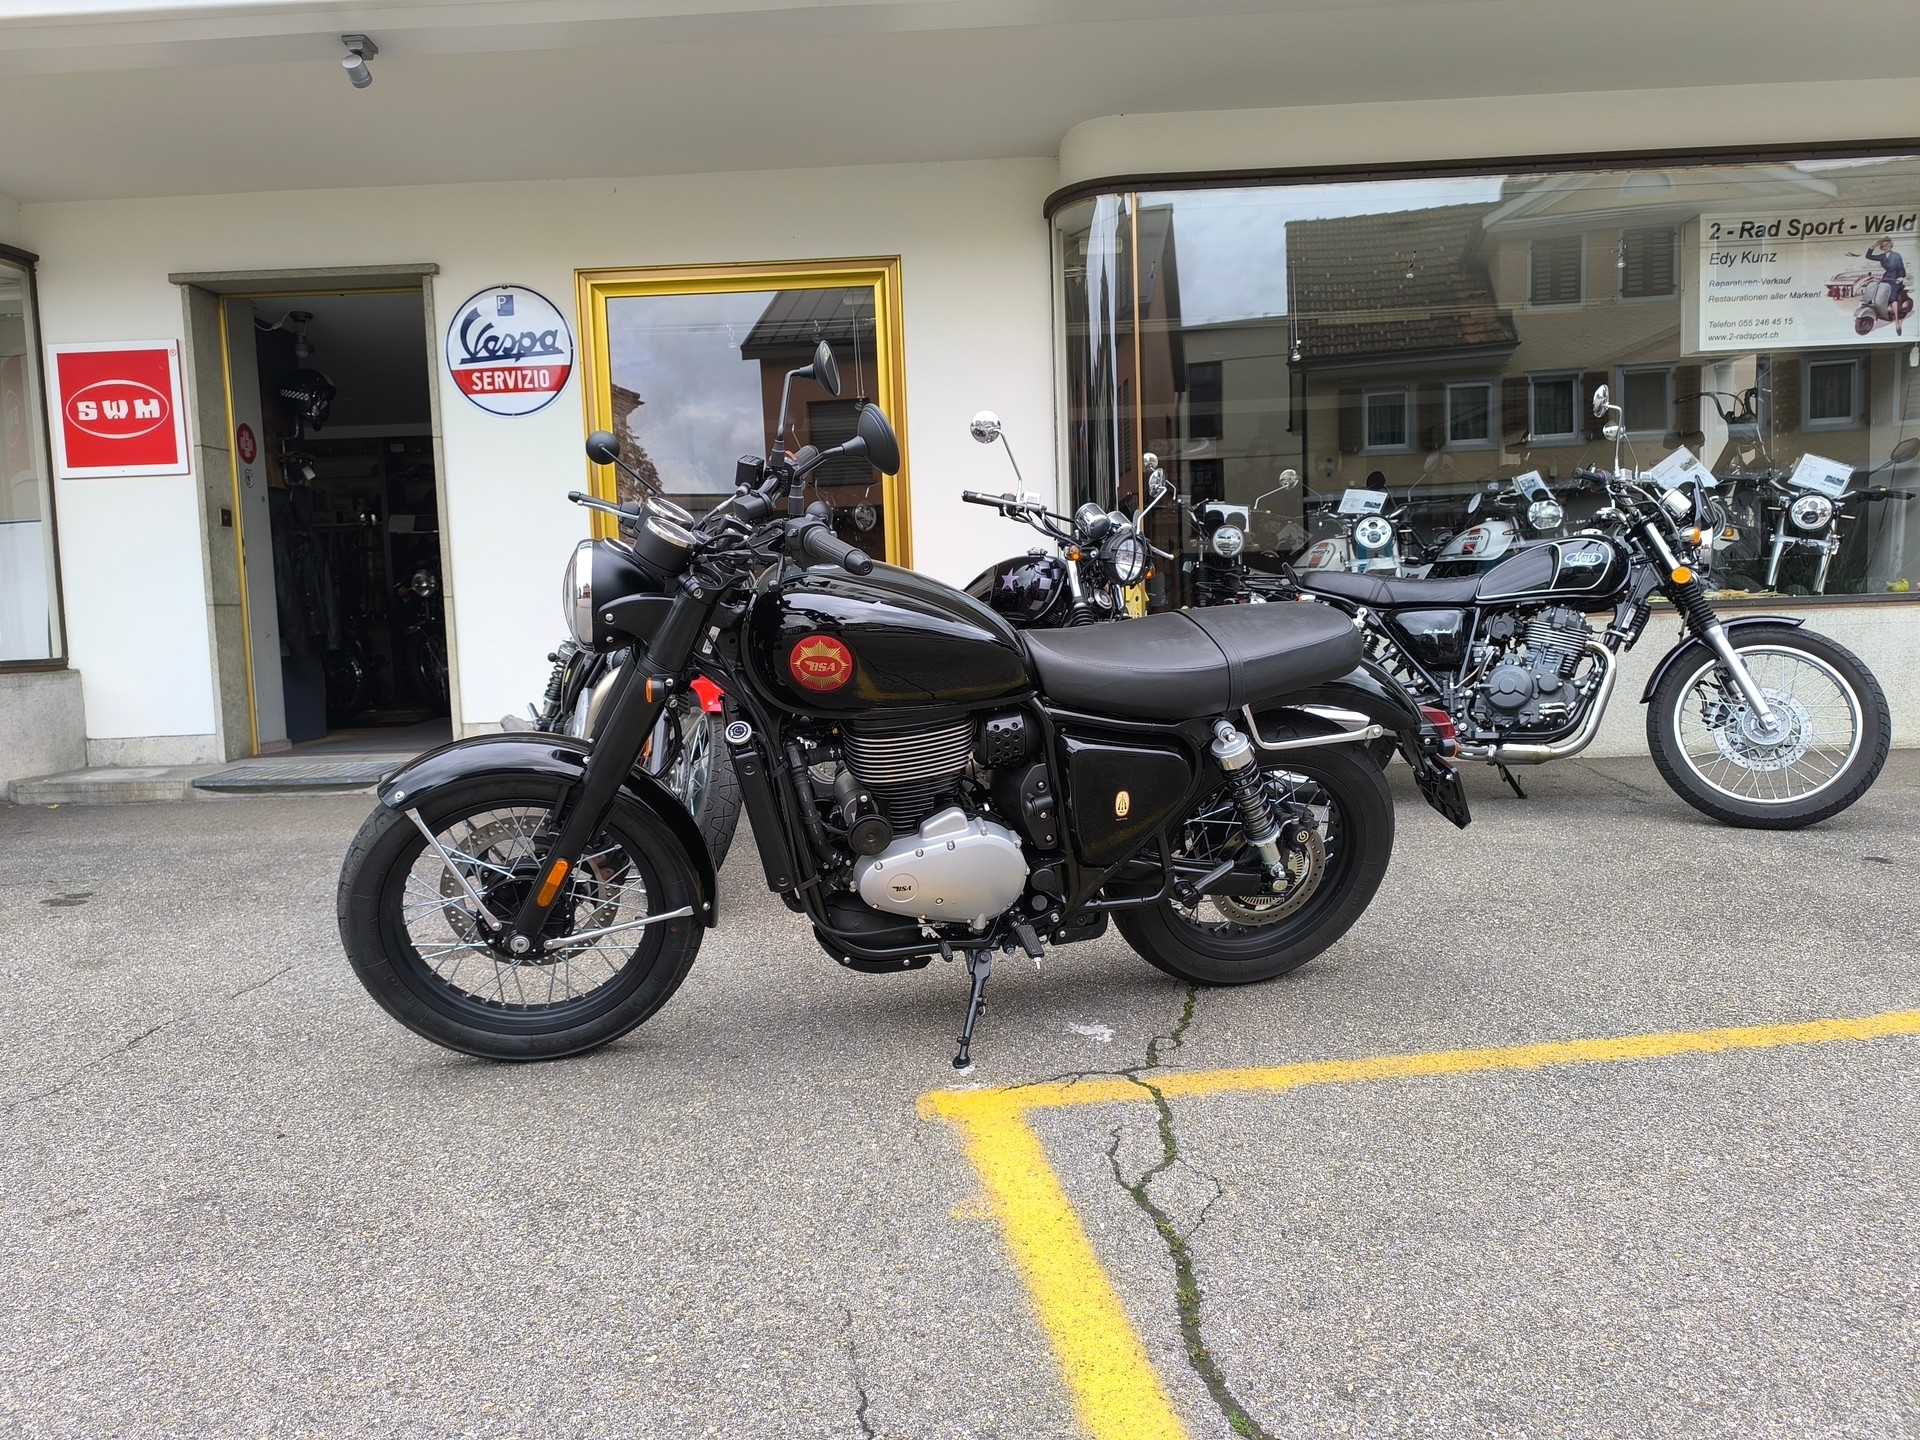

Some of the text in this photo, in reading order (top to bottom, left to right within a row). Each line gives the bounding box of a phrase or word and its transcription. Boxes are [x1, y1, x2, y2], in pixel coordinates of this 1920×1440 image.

[1709, 221, 1721, 240] 2
[1739, 219, 1781, 239] Rad
[1786, 217, 1845, 240] Sport
[1864, 214, 1917, 233] Wald
[1709, 250, 1778, 267] Edy Kunz
[1708, 276, 1792, 288] Reparaturen-Verkauf
[1769, 291, 1787, 300] aller
[1789, 290, 1821, 299] Marken!
[1708, 317, 1794, 329] Telefon 055 246 45 15
[459, 307, 564, 365] Vespa
[1707, 331, 1779, 341] www.2-radsport.ch
[471, 369, 550, 391] SERVIZIO
[77, 398, 161, 420] SWM
[804, 660, 836, 672] BSA
